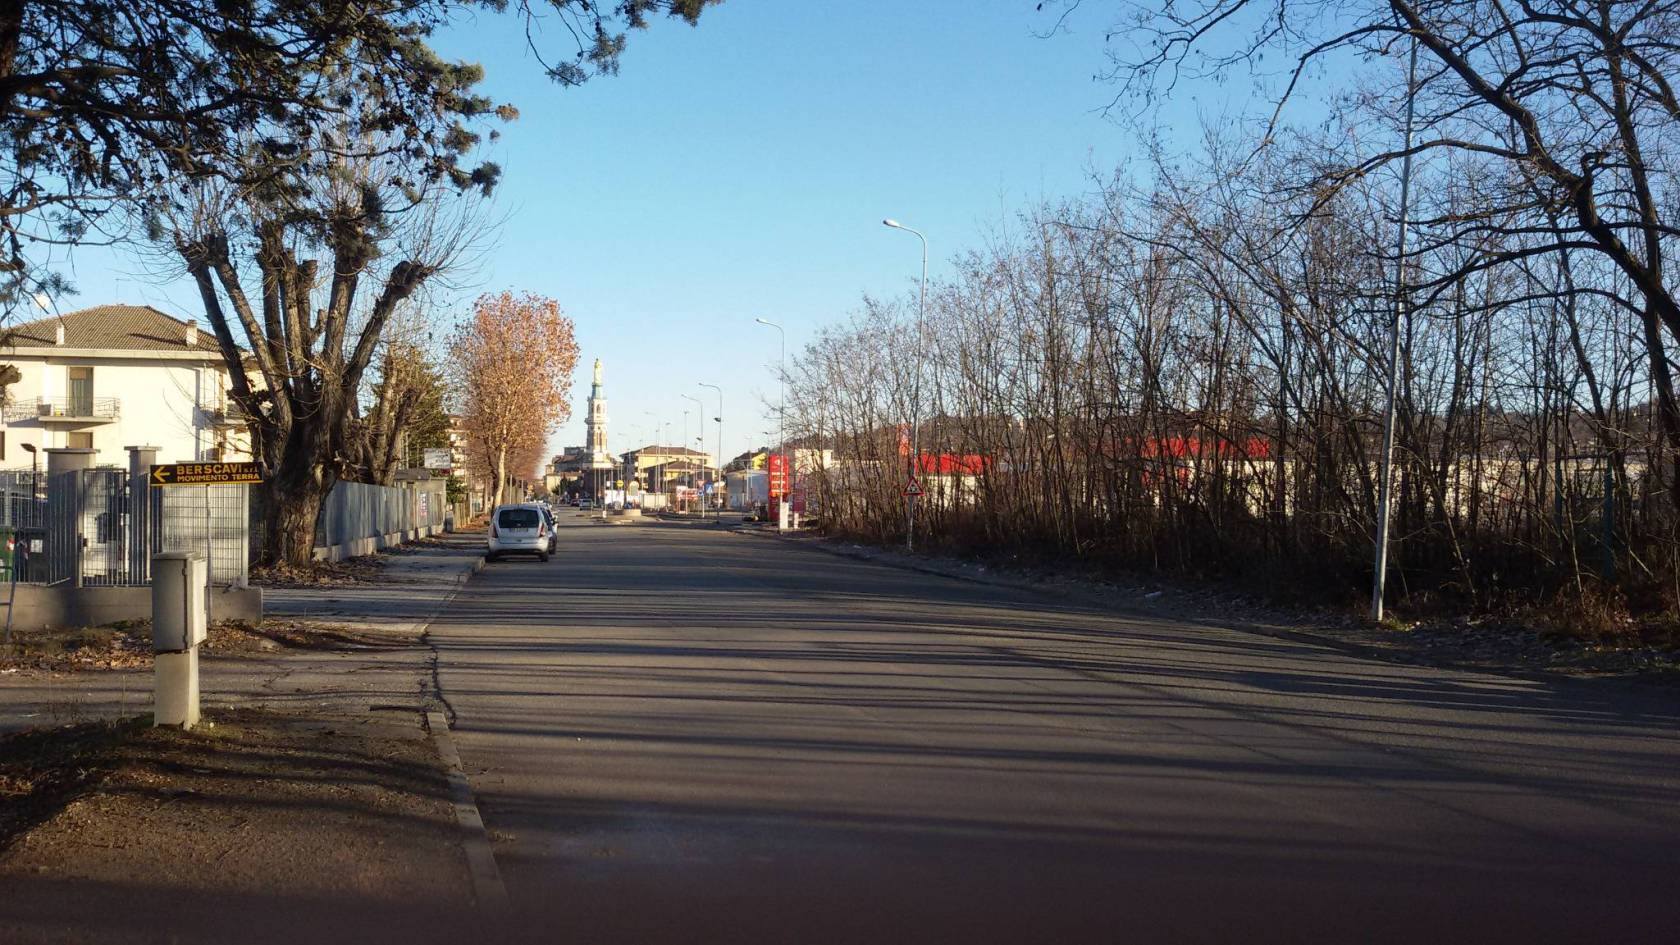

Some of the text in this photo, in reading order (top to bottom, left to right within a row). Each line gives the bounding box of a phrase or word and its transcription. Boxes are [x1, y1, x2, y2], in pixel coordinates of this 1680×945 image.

[177, 464, 242, 475] BERSCAVI
[177, 473, 260, 482] MOVIMENTO TERRA
